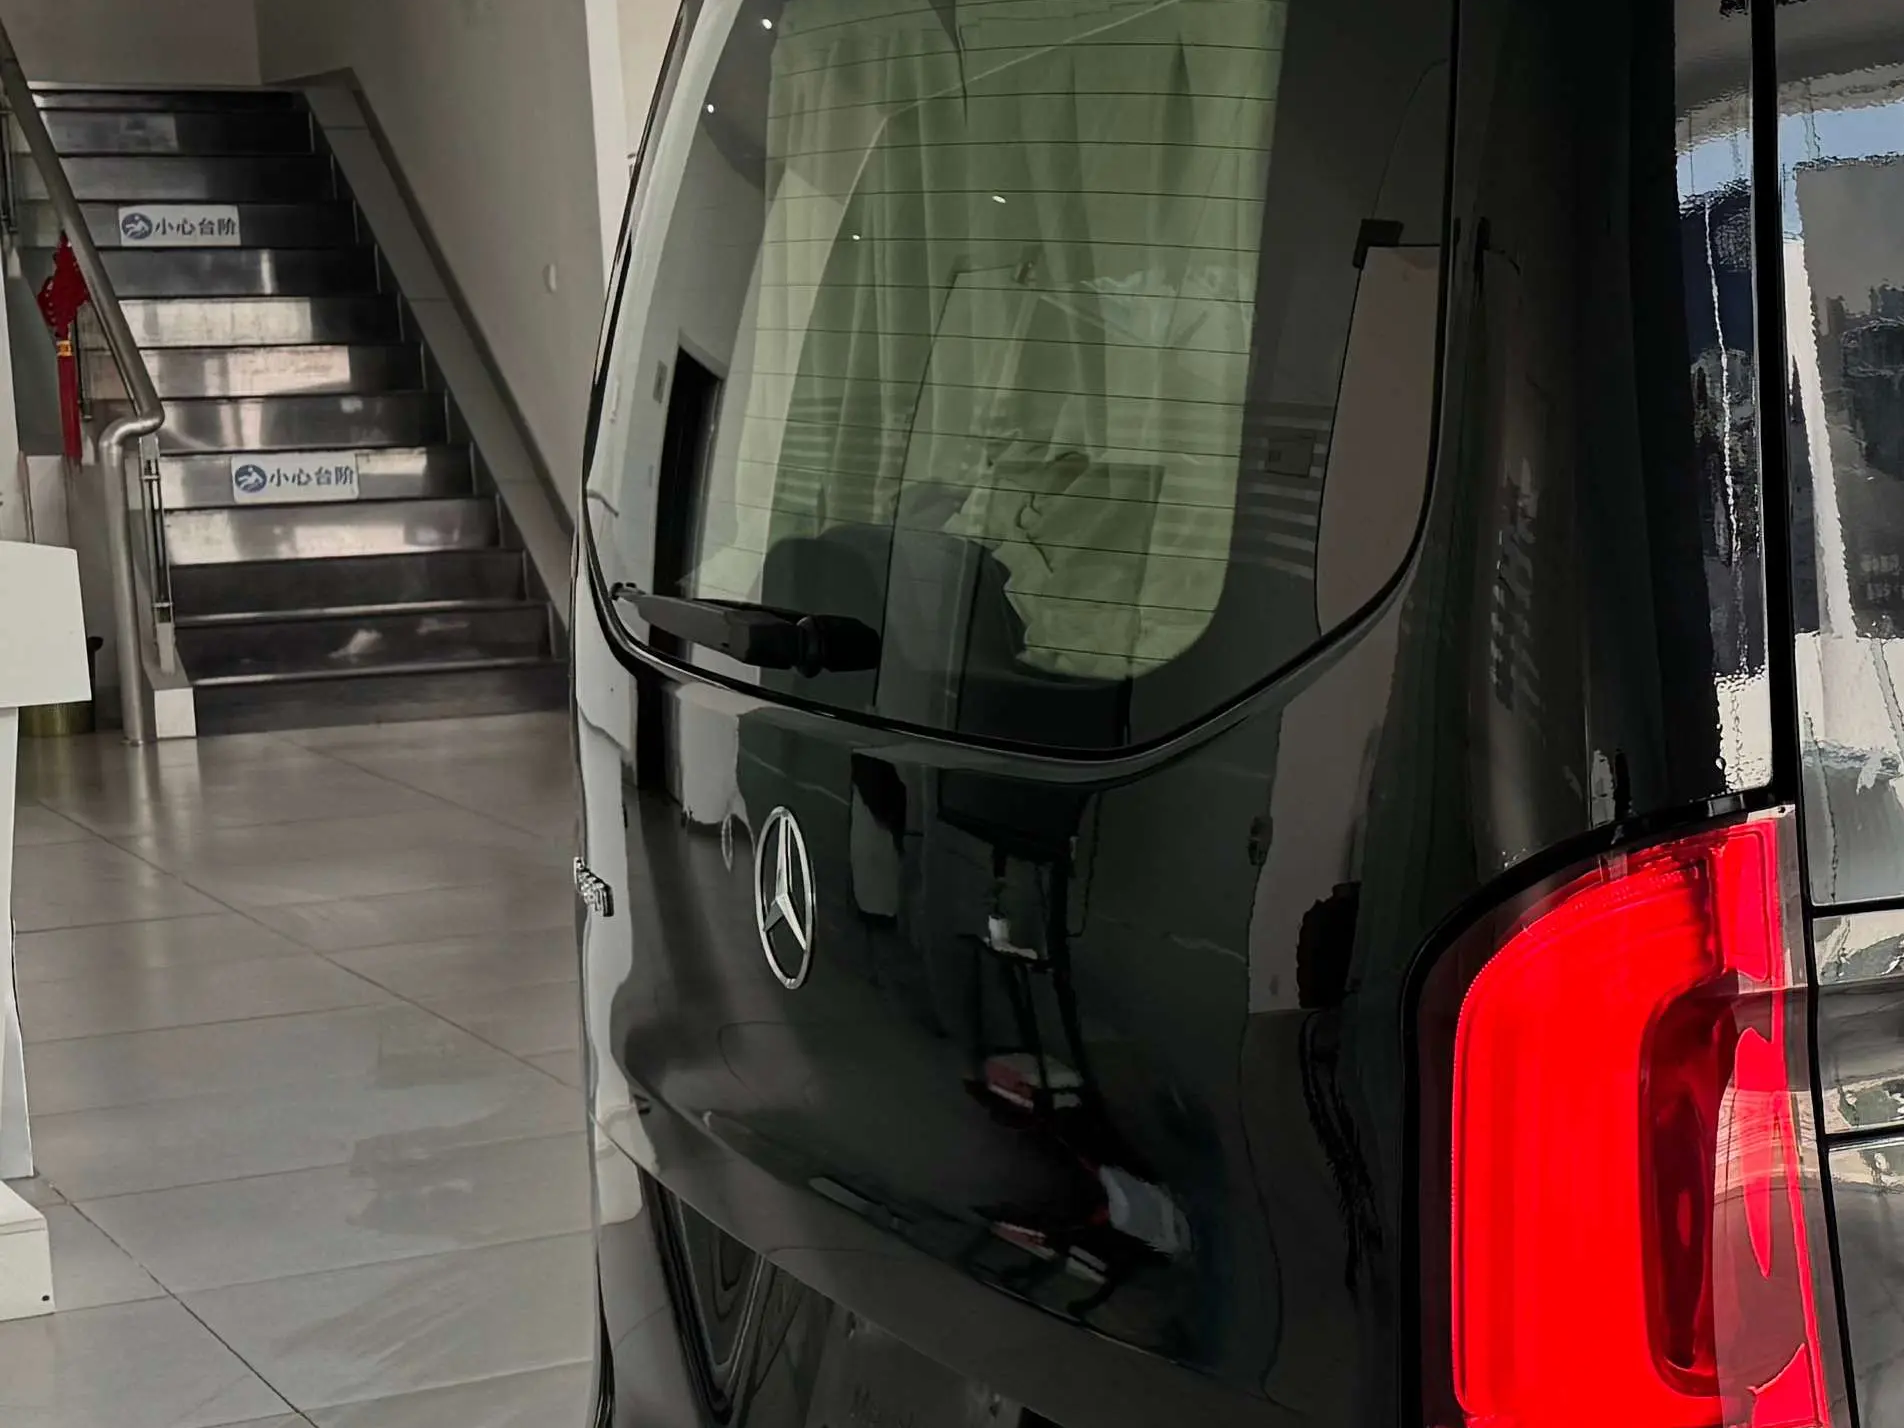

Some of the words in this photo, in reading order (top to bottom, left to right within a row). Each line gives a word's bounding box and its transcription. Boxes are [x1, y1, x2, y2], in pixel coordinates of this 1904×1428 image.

[155, 217, 236, 236] 小心台阶
[269, 466, 353, 487] 小心台阶
